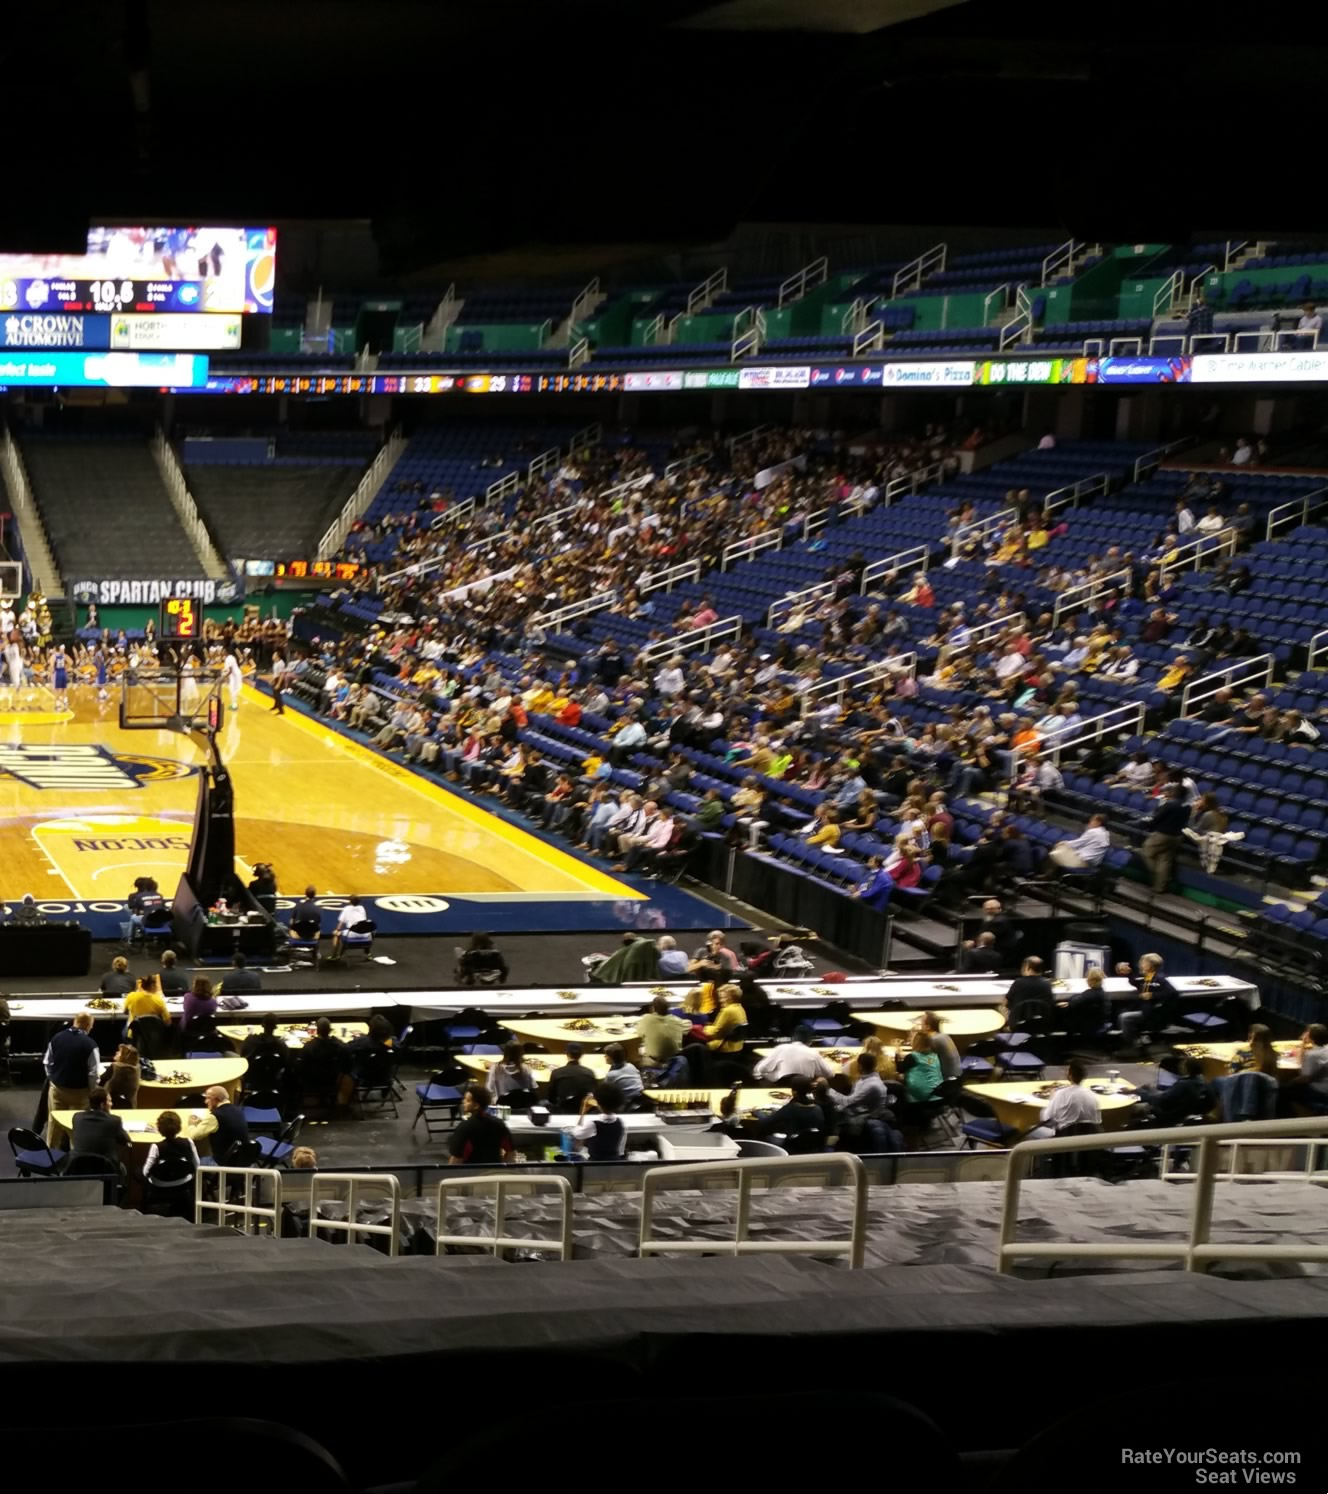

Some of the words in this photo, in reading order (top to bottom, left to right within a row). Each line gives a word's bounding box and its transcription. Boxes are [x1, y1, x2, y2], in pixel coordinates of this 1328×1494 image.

[20, 315, 84, 333] CROWN
[5, 332, 84, 346] AUTOMOTIVE
[1289, 357, 1322, 371] Cable
[896, 367, 940, 382] Domino's
[943, 367, 971, 381] Pizza
[100, 580, 172, 604] SPARTAN
